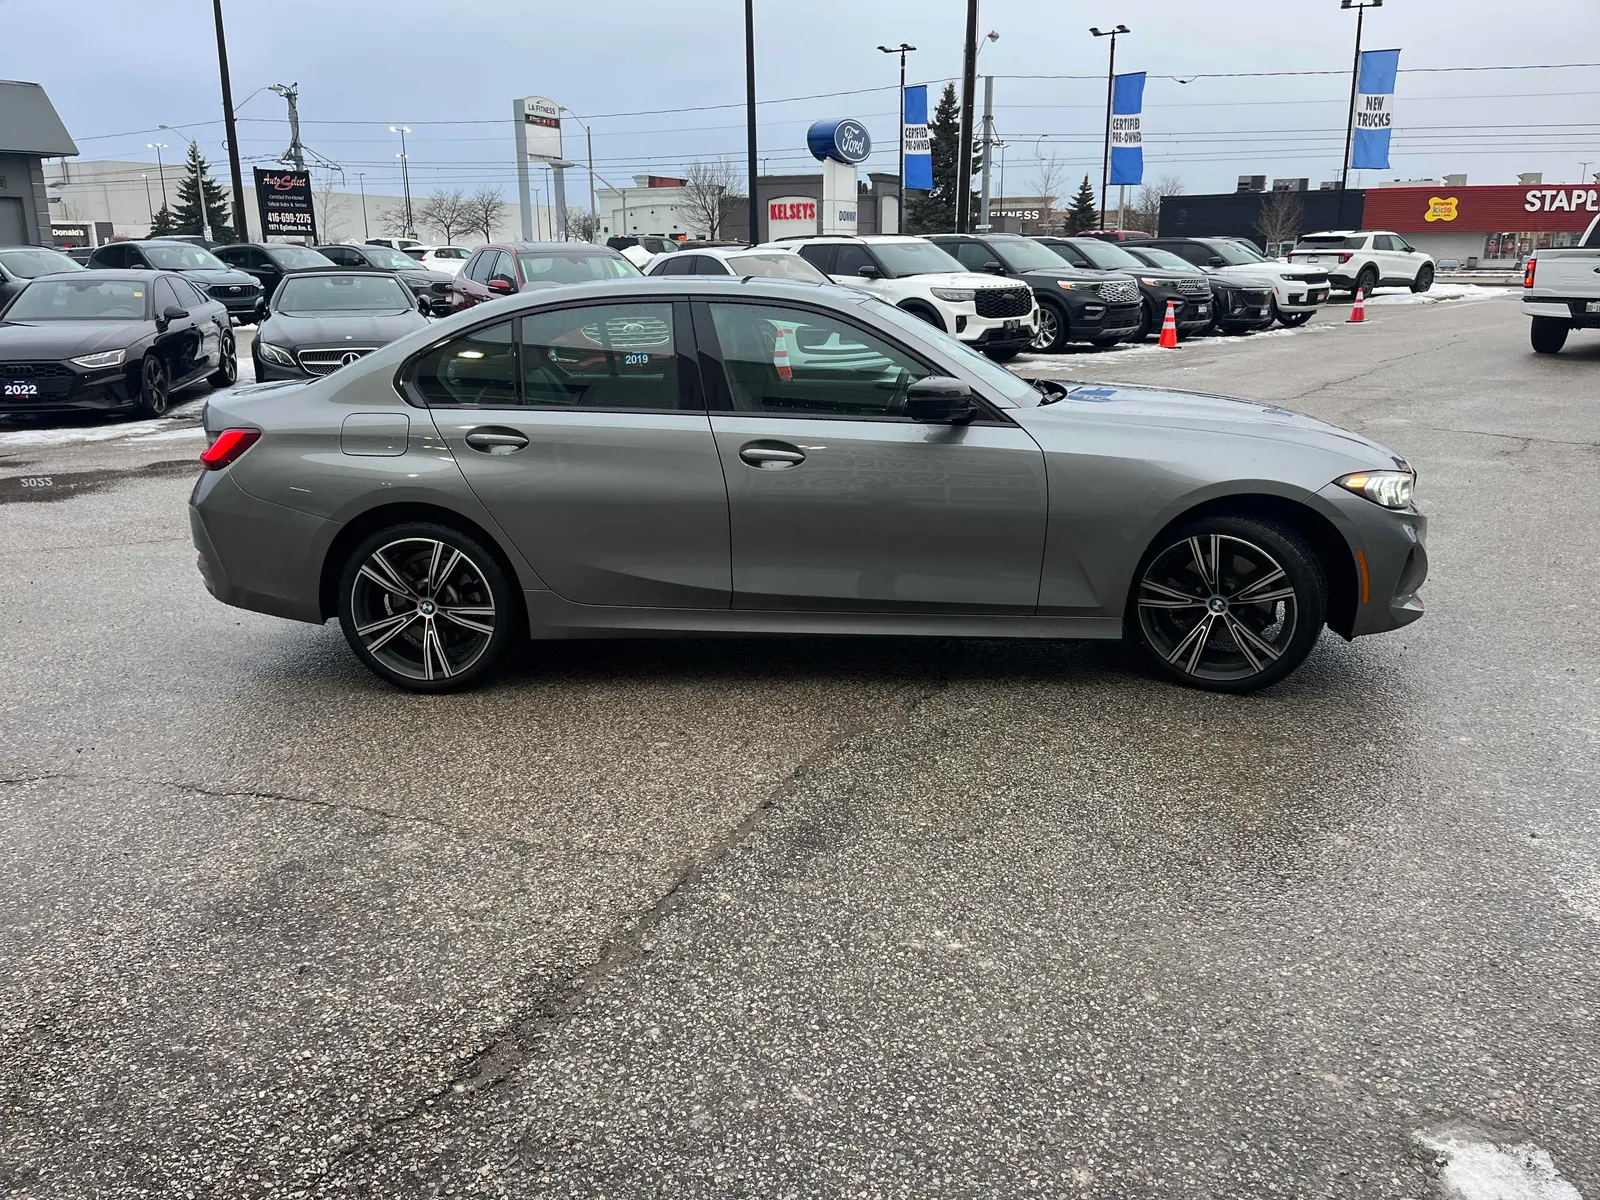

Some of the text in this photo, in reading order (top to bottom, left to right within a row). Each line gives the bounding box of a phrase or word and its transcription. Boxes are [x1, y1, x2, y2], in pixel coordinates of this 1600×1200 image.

[1366, 96, 1384, 111] NEW
[1113, 117, 1140, 130] CERTIFIED
[1358, 112, 1391, 127] TRUCKS
[842, 125, 865, 155] Ford
[1113, 131, 1142, 143] PRE-OWNED
[1524, 189, 1600, 212] STAPL
[267, 212, 312, 223] 416-699-2275
[770, 203, 815, 220] KELSEYS
[625, 354, 649, 364] 2019
[4, 384, 38, 395] 2022
